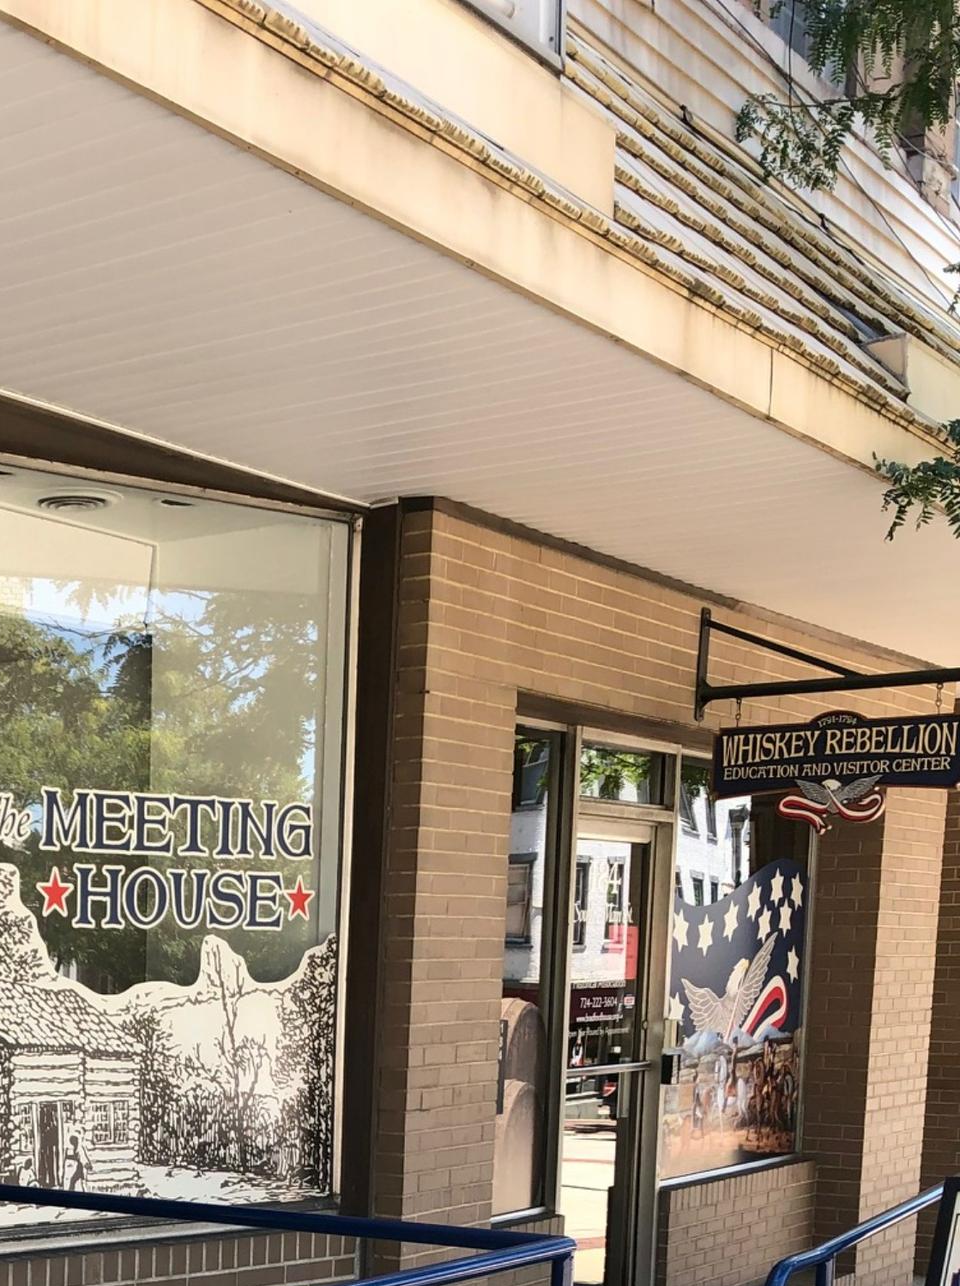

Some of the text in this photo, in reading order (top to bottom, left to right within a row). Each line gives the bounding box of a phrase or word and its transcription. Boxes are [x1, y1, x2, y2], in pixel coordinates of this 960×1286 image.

[722, 721, 959, 768] WHISKEY REBELLION
[723, 756, 951, 781] EDUCATION AND VISITOR CENTER
[39, 786, 315, 860] MEETING
[71, 863, 285, 932] HOUSE
